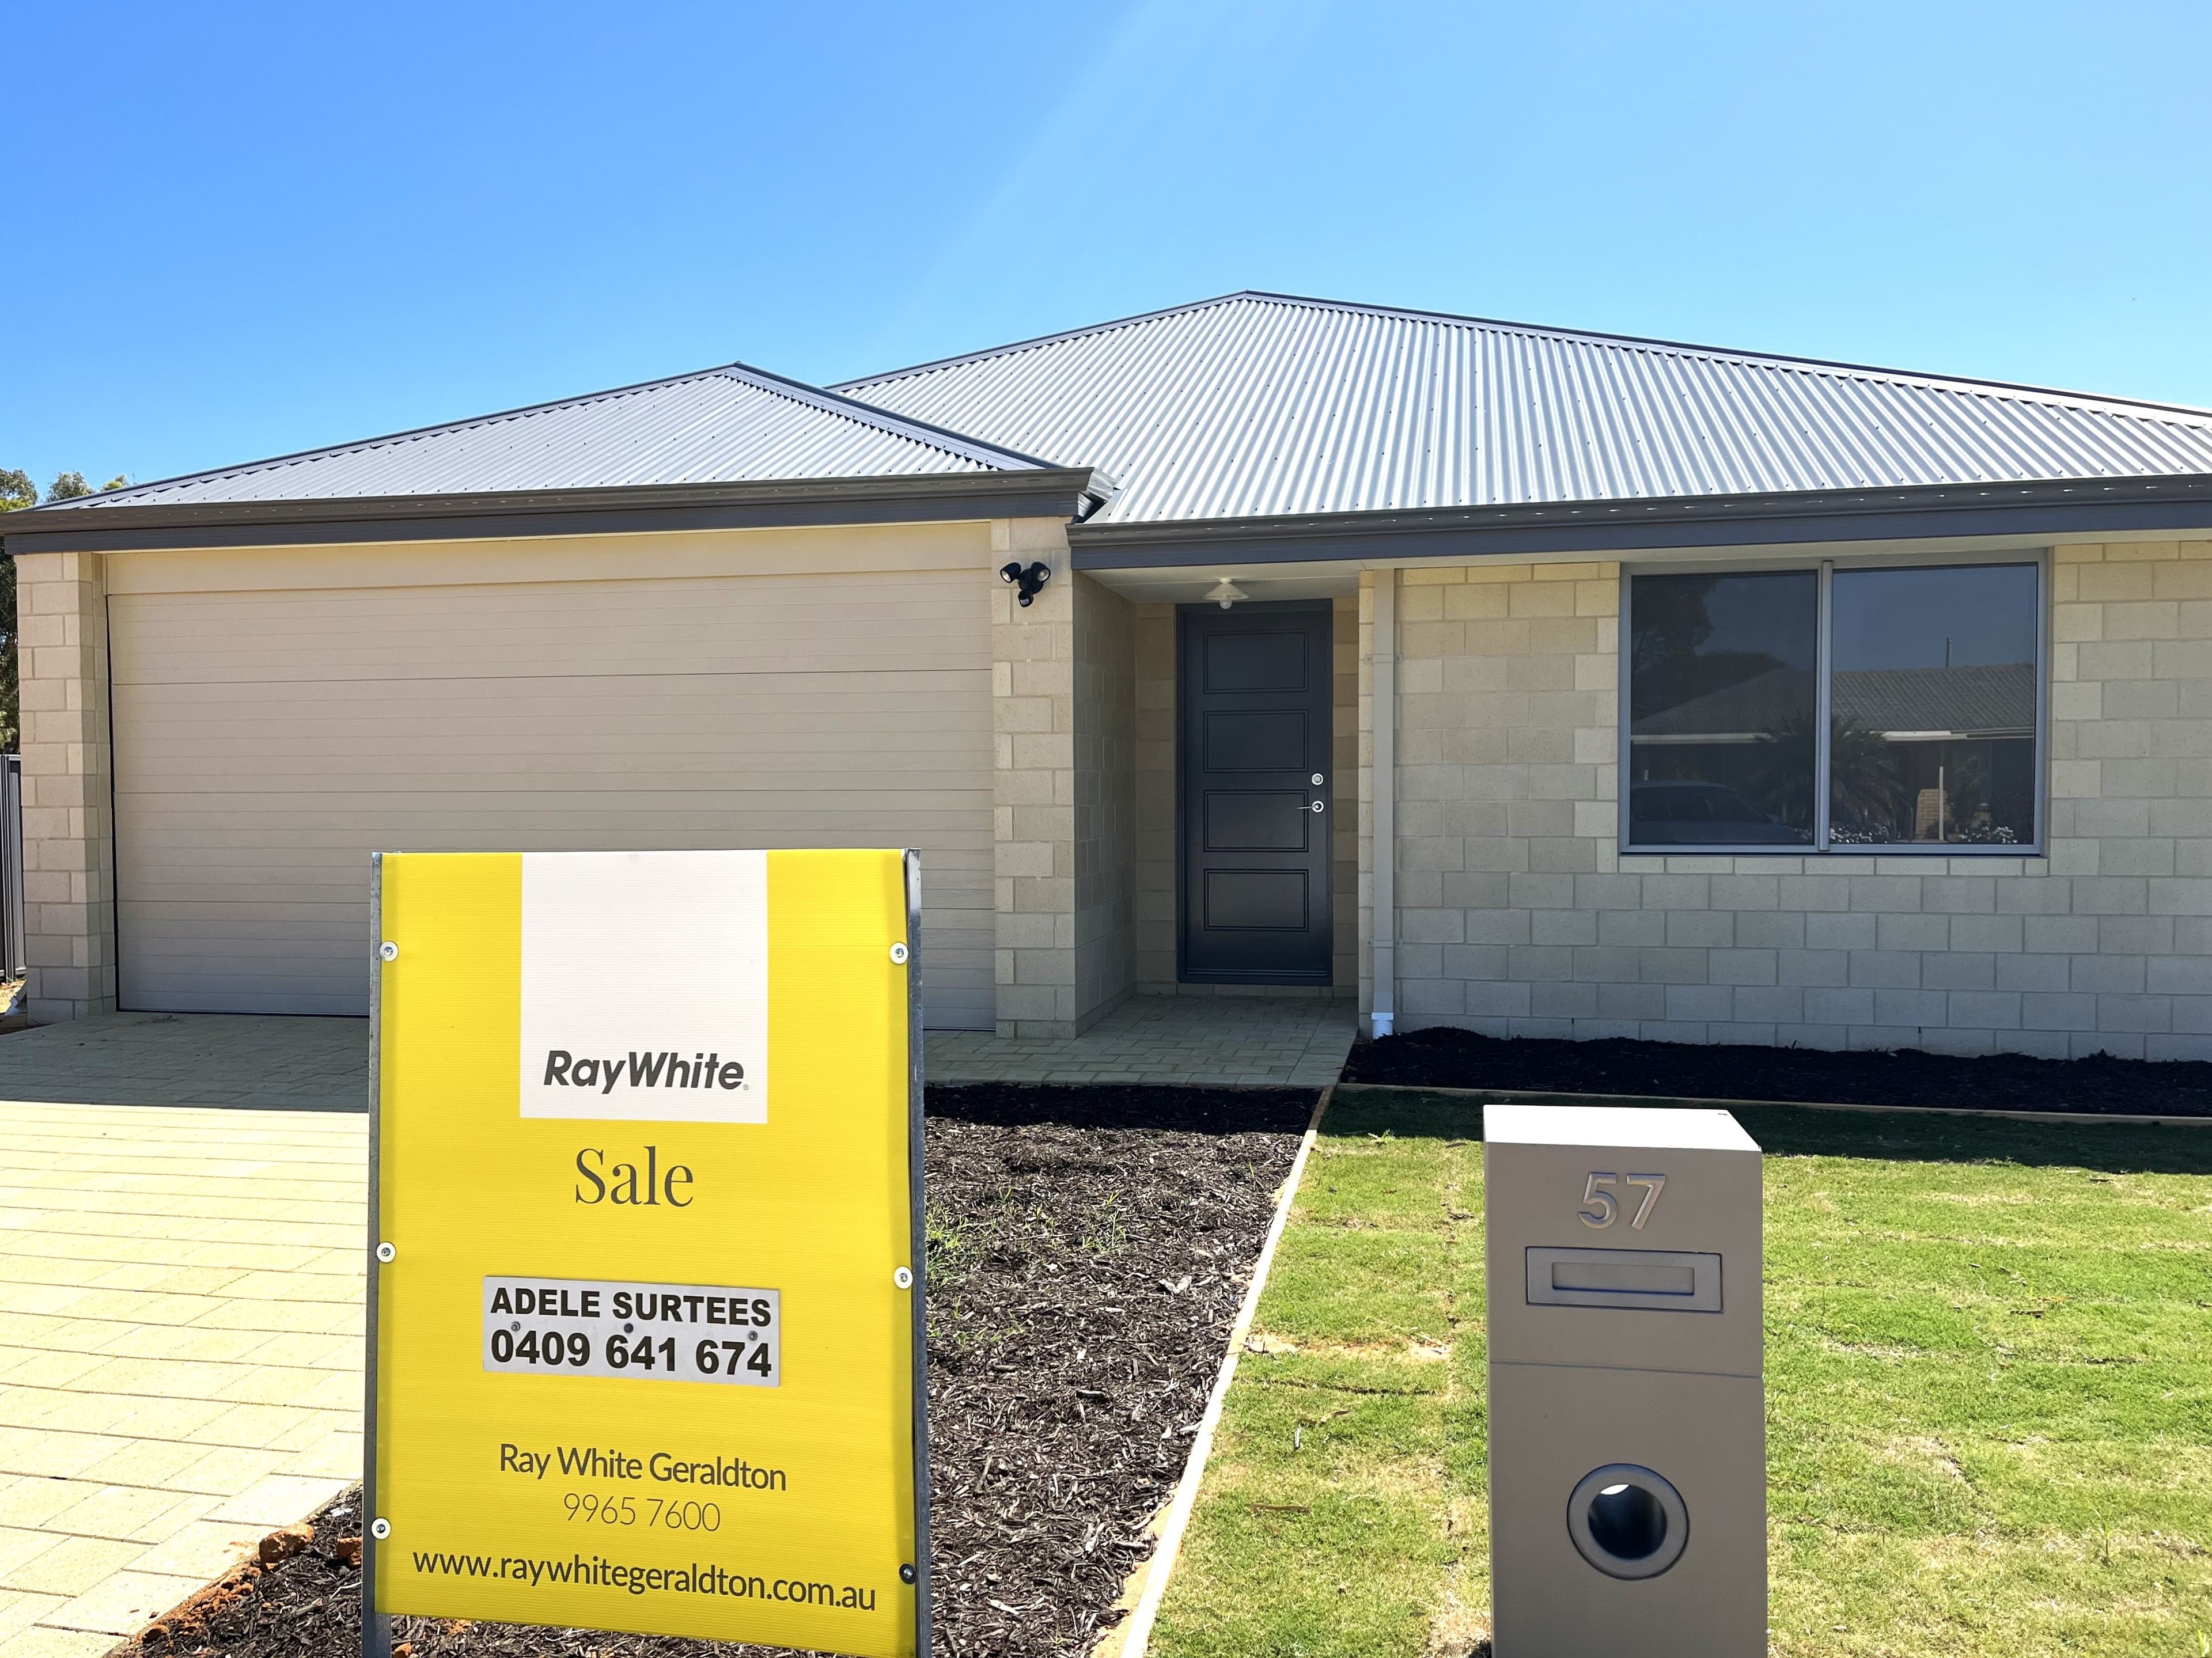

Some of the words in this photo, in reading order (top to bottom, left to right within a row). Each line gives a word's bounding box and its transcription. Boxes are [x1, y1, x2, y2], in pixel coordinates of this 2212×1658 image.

[575, 1146, 694, 1207] Sale
[1578, 1172, 1666, 1231] 57
[490, 1288, 601, 1318] ADELE
[612, 1292, 771, 1326] SURTEES
[491, 1329, 590, 1367] 0409
[605, 1336, 676, 1371] 641
[695, 1340, 771, 1377] 674
[499, 1444, 551, 1479] Ray
[556, 1447, 643, 1479] White
[649, 1452, 787, 1491] Geraldton
[563, 1493, 635, 1525] 9965
[646, 1498, 721, 1532] 7600
[412, 1551, 876, 1611] www.raywhitegeraldton.com.au
